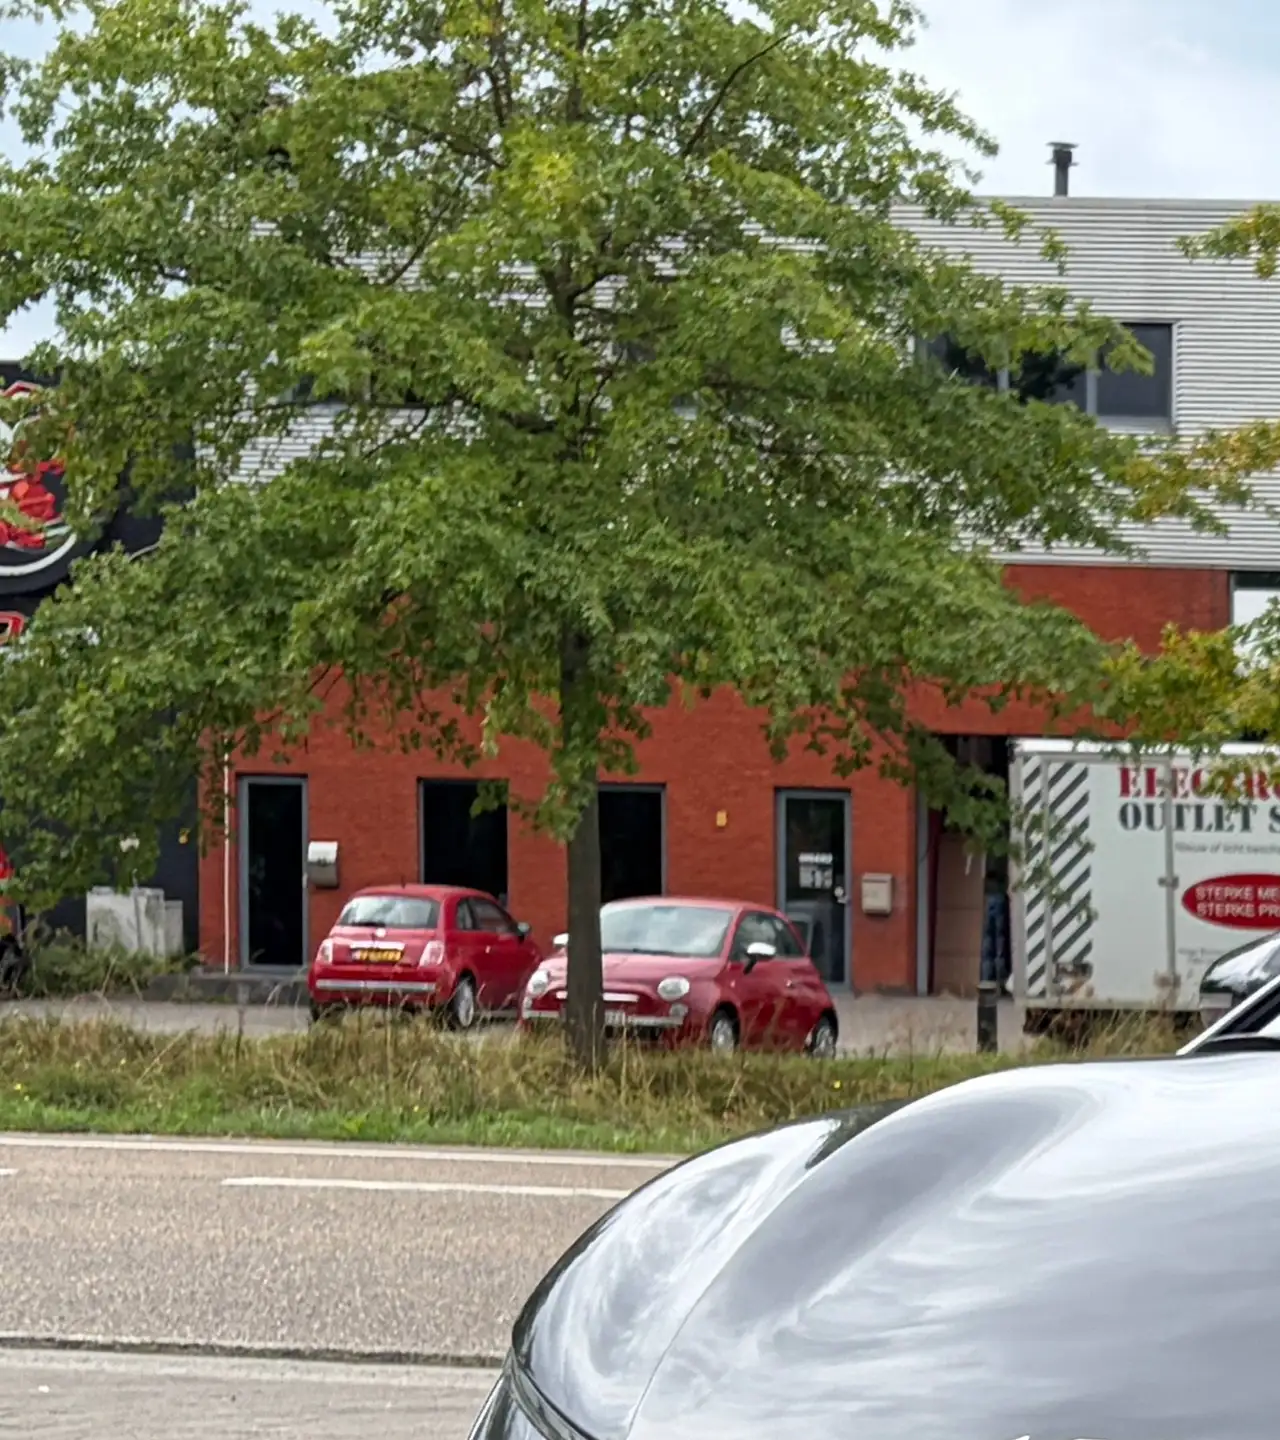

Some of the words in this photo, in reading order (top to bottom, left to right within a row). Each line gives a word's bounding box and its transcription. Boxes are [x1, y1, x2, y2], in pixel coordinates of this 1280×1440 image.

[1118, 802, 1257, 833] OUTLET
[1195, 886, 1252, 899] STERKE
[1197, 902, 1254, 917] STERKE
